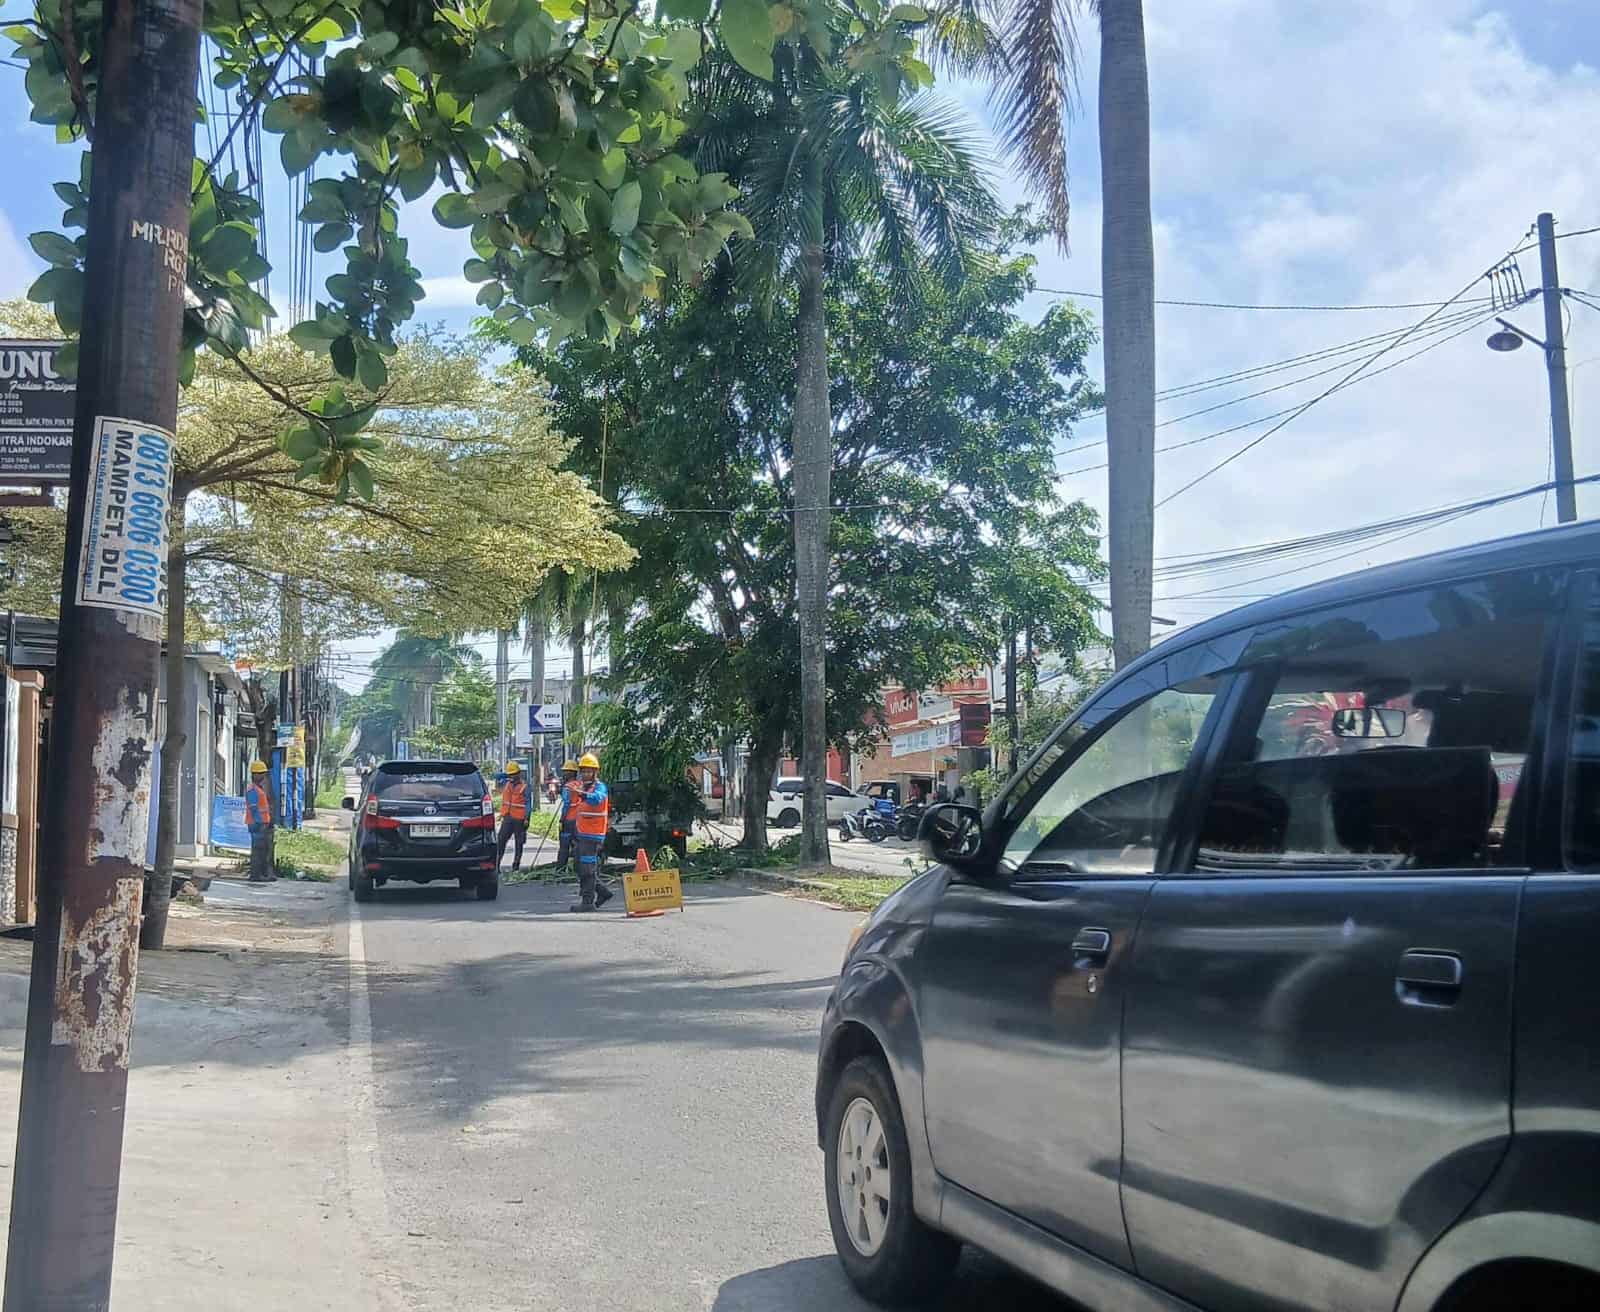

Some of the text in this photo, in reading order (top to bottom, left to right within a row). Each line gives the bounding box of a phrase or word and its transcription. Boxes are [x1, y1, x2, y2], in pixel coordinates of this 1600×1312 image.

[133, 432, 169, 489] 0813
[97, 429, 133, 595] MAMPET, DLL
[126, 490, 165, 548] 6606
[119, 547, 161, 605] 0300
